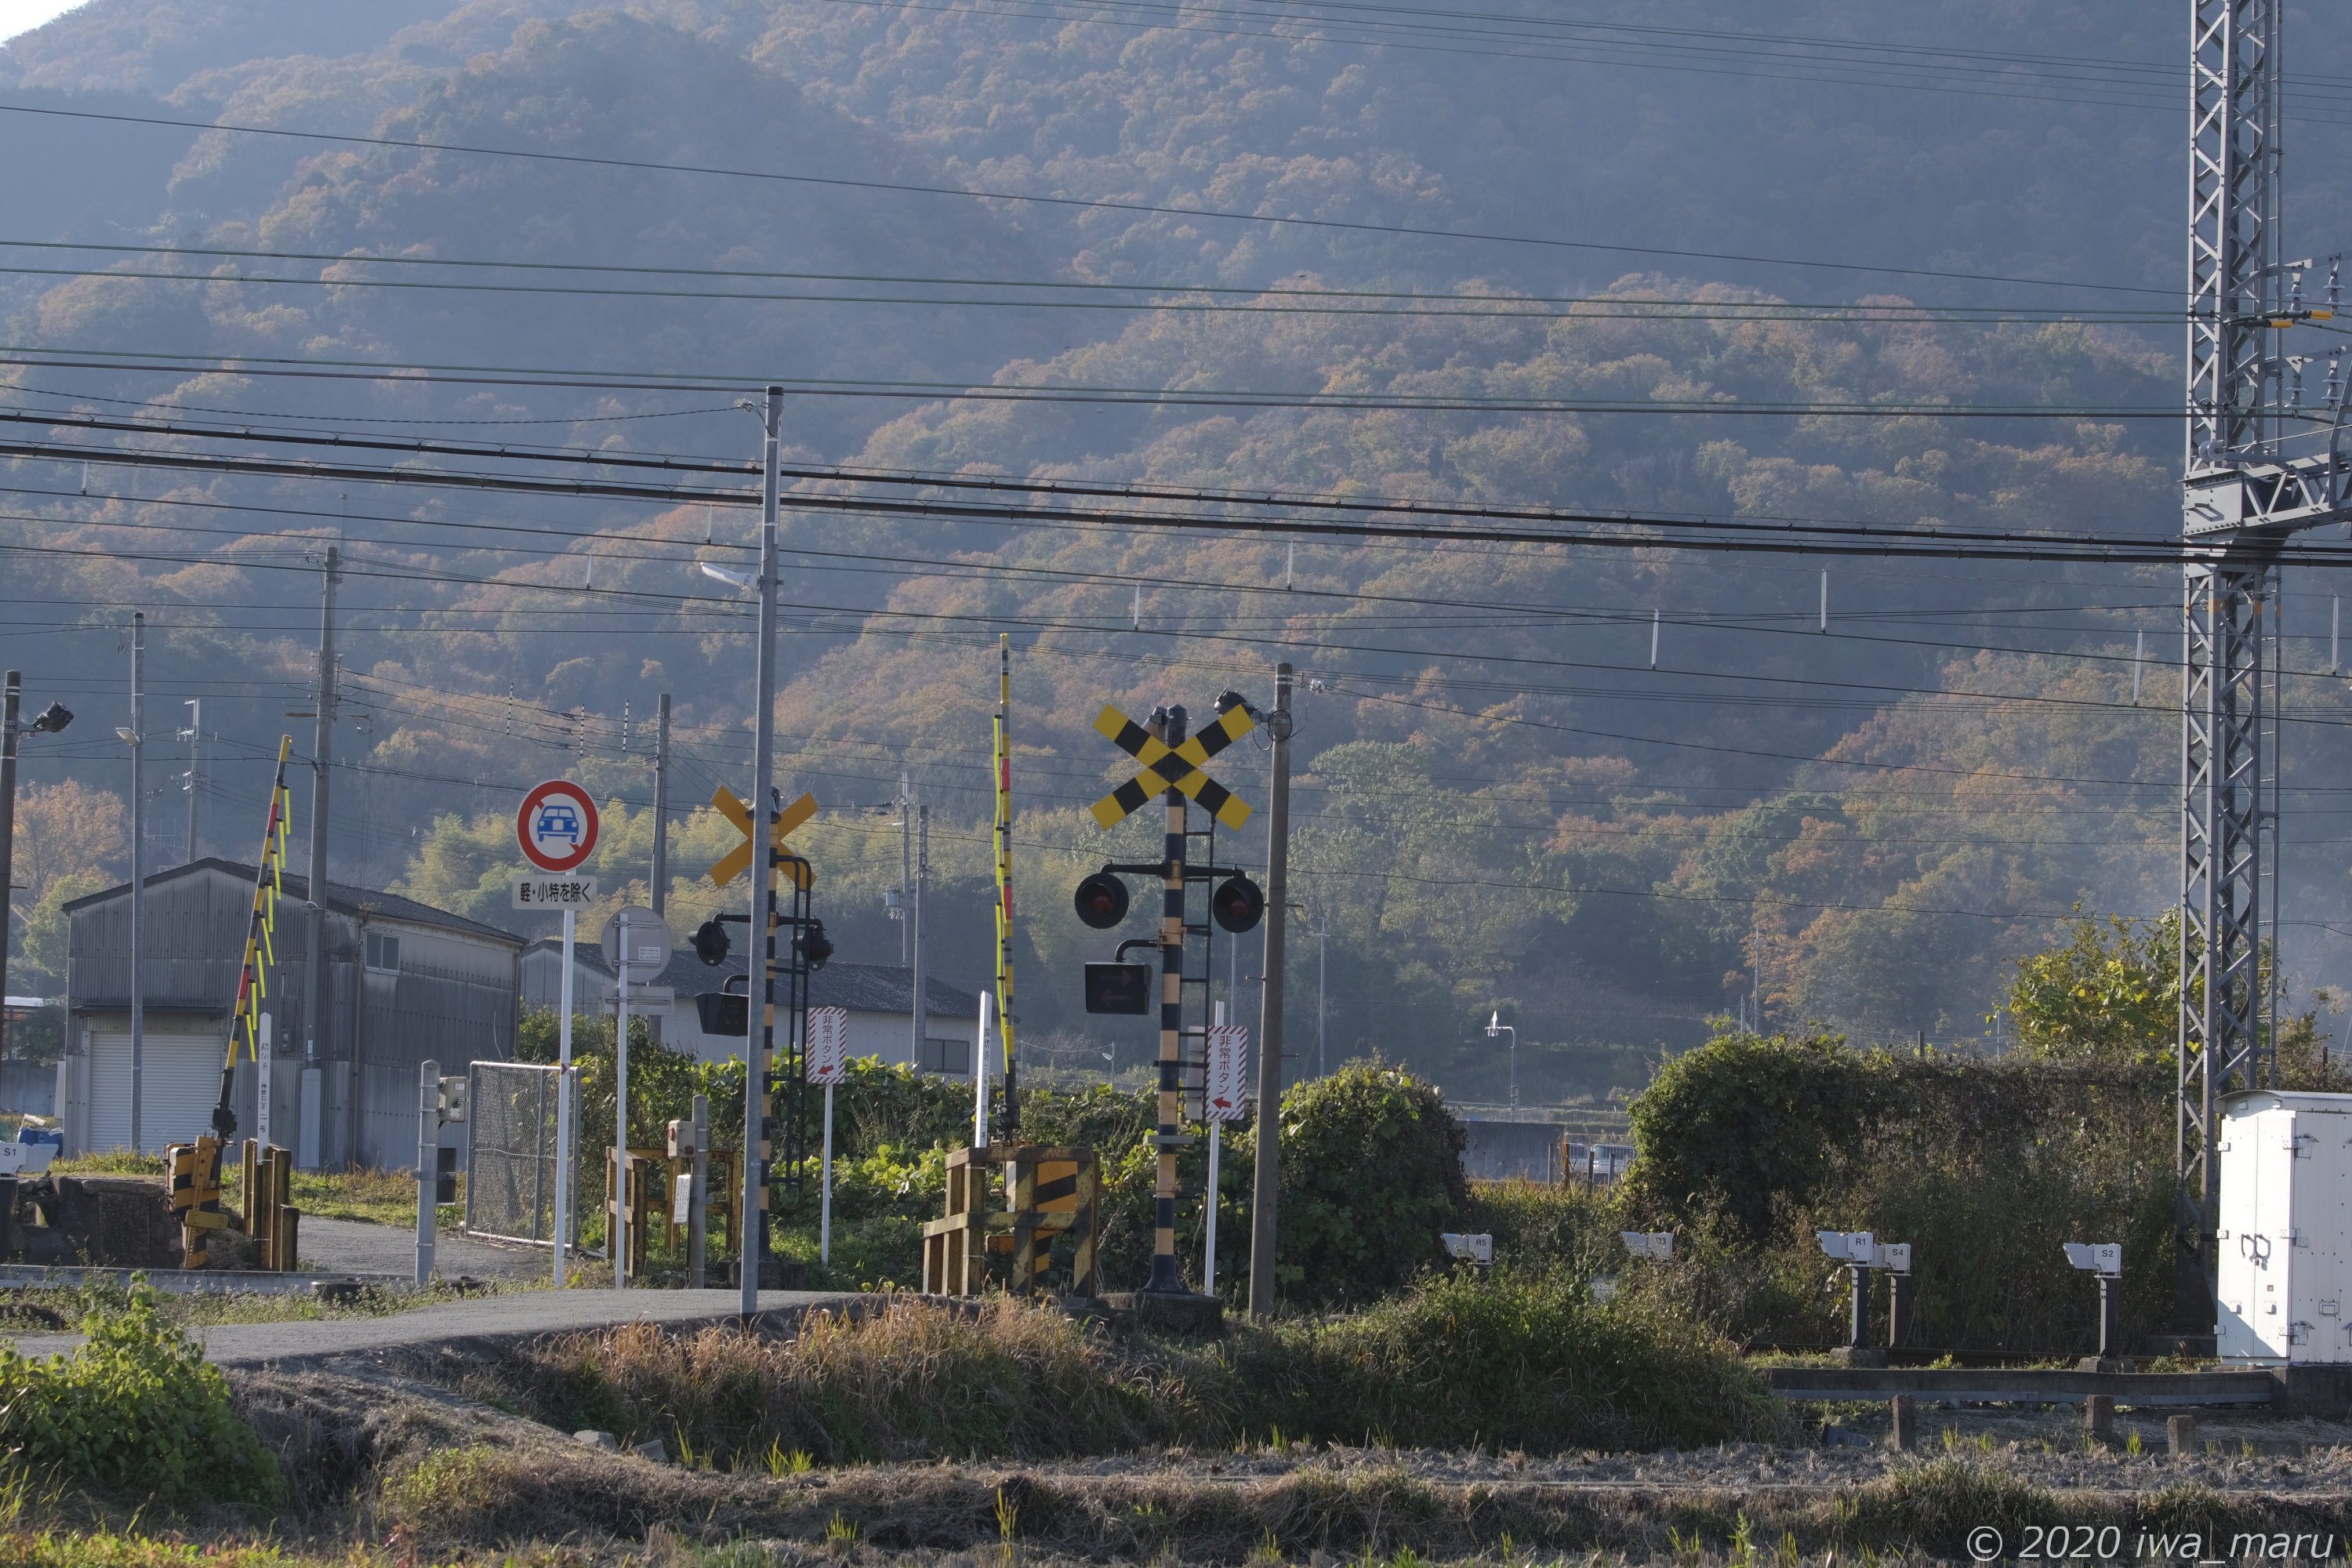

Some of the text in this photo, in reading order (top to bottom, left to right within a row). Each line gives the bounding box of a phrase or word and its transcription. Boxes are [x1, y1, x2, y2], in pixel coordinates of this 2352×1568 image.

[520, 882, 590, 903] 軽・小特を除く
[822, 1014, 833, 1063] 非常ボタン
[1218, 1034, 1232, 1095] 非常ボタン
[4, 1148, 16, 1156] S1
